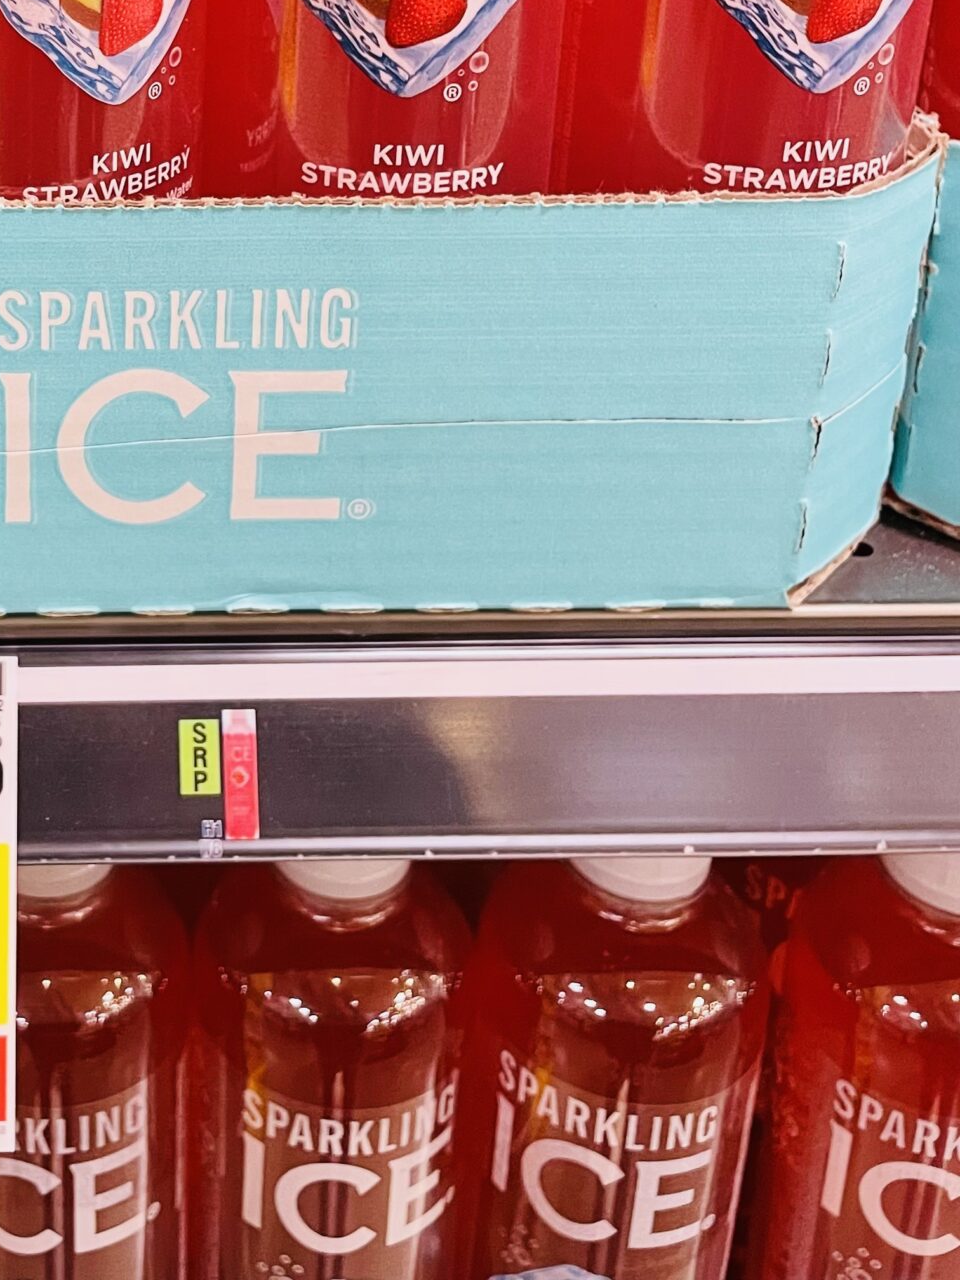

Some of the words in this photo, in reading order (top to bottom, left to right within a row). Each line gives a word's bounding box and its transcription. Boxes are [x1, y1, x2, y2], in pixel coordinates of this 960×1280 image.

[22, 146, 191, 204] STRAWBERRY
[93, 142, 151, 175] KIWI
[301, 162, 504, 194] STRAWBERRY
[373, 144, 444, 166] KIWI
[703, 152, 892, 190] STRAWBERRY
[783, 138, 850, 163] KIWI
[15, 1092, 147, 1154] KLING
[242, 1069, 456, 1156] SPARKLING
[498, 1050, 718, 1151] SPARKLING
[833, 1078, 960, 1162] SPARK
[242, 1122, 452, 1254] ICE
[492, 1091, 712, 1249] ICE
[820, 1118, 960, 1257] IC
